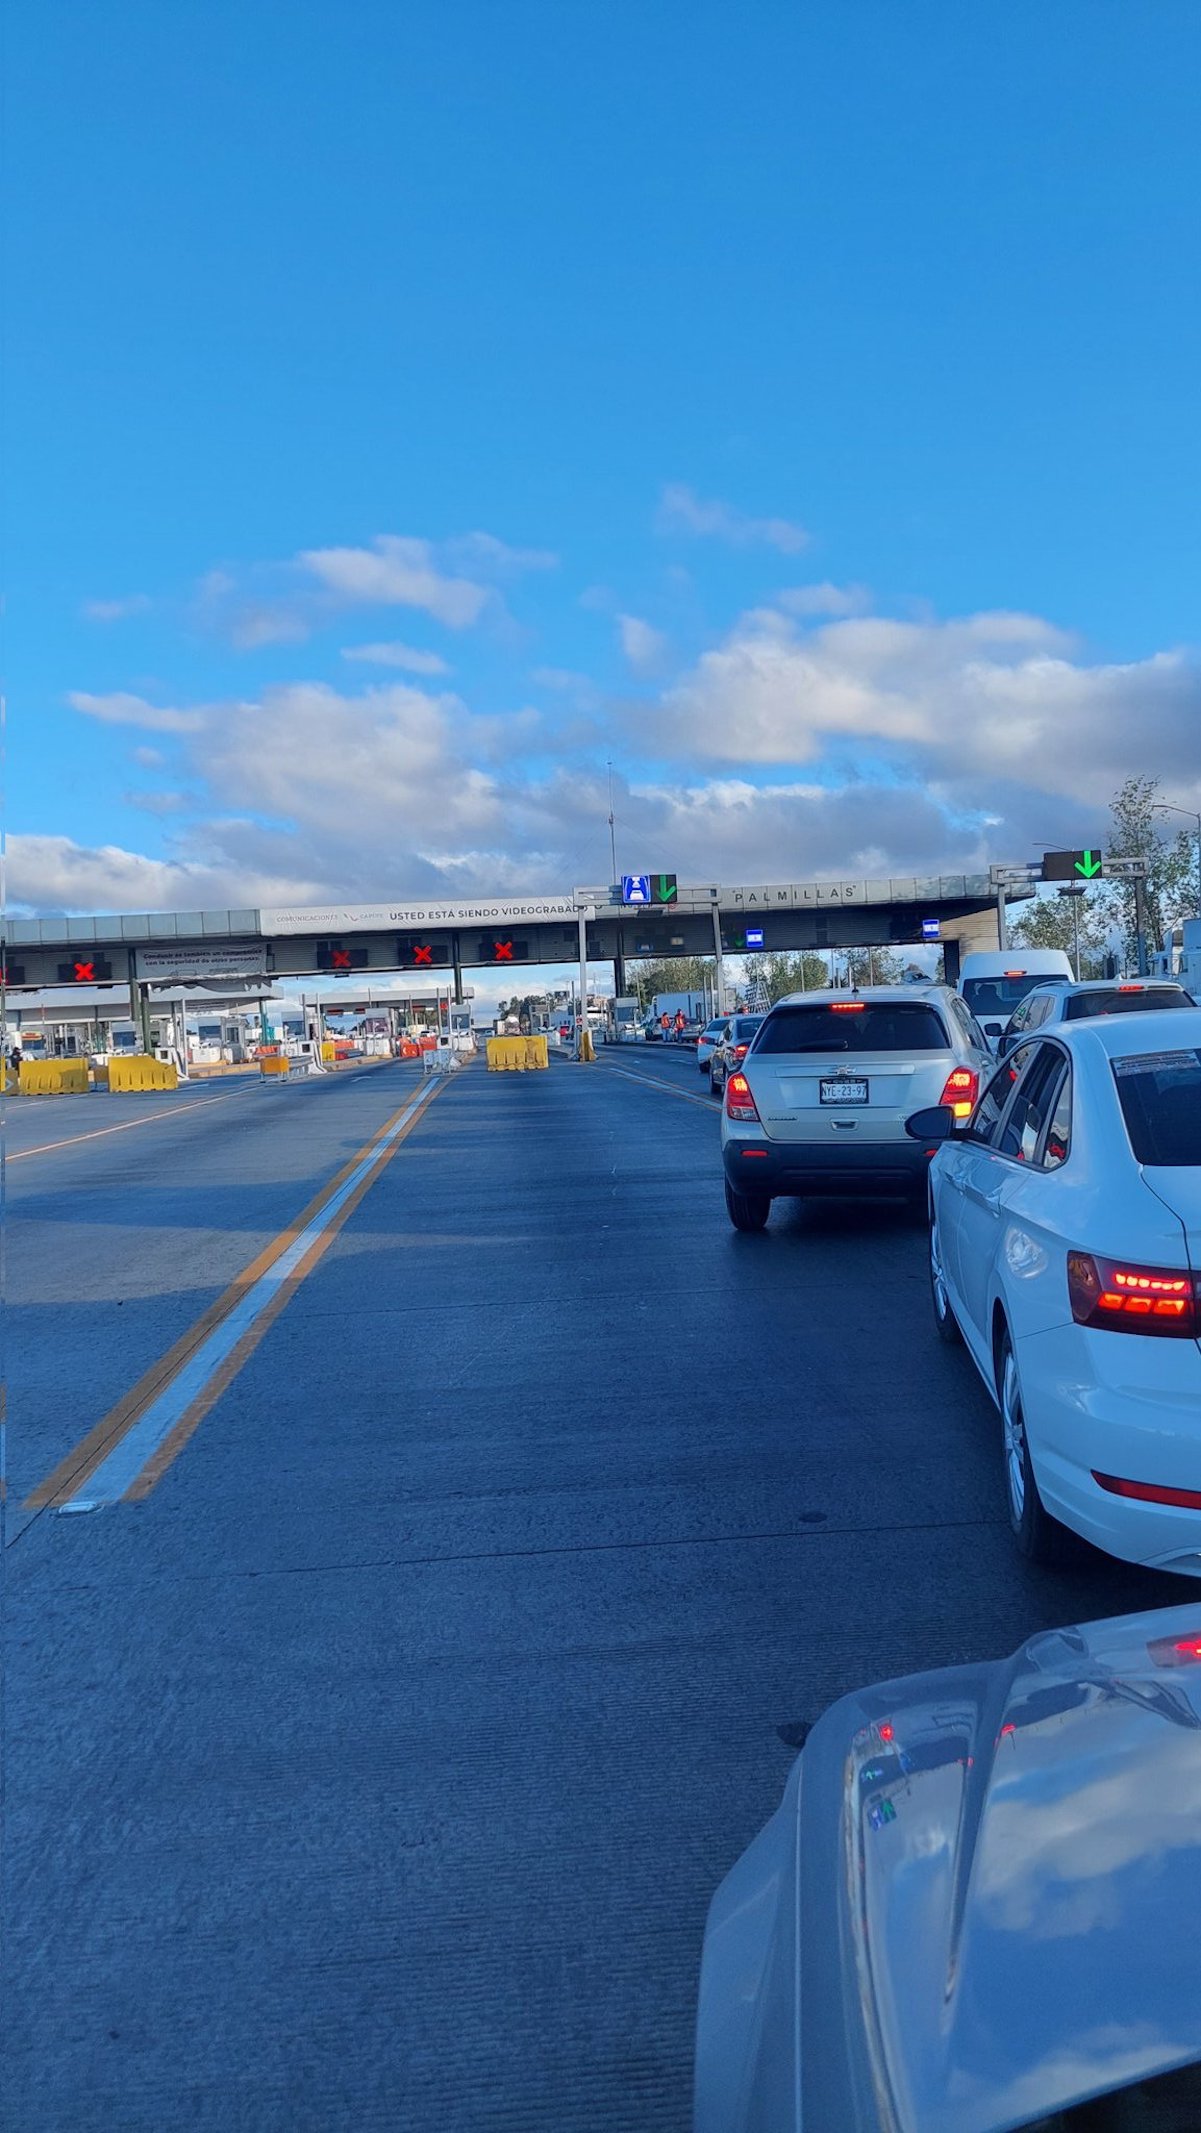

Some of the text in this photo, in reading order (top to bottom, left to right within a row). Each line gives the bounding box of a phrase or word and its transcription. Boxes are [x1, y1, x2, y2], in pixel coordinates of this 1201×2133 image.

[389, 911, 425, 920] USTED
[428, 908, 455, 919] ESTÁ
[458, 907, 499, 918] SIENDO
